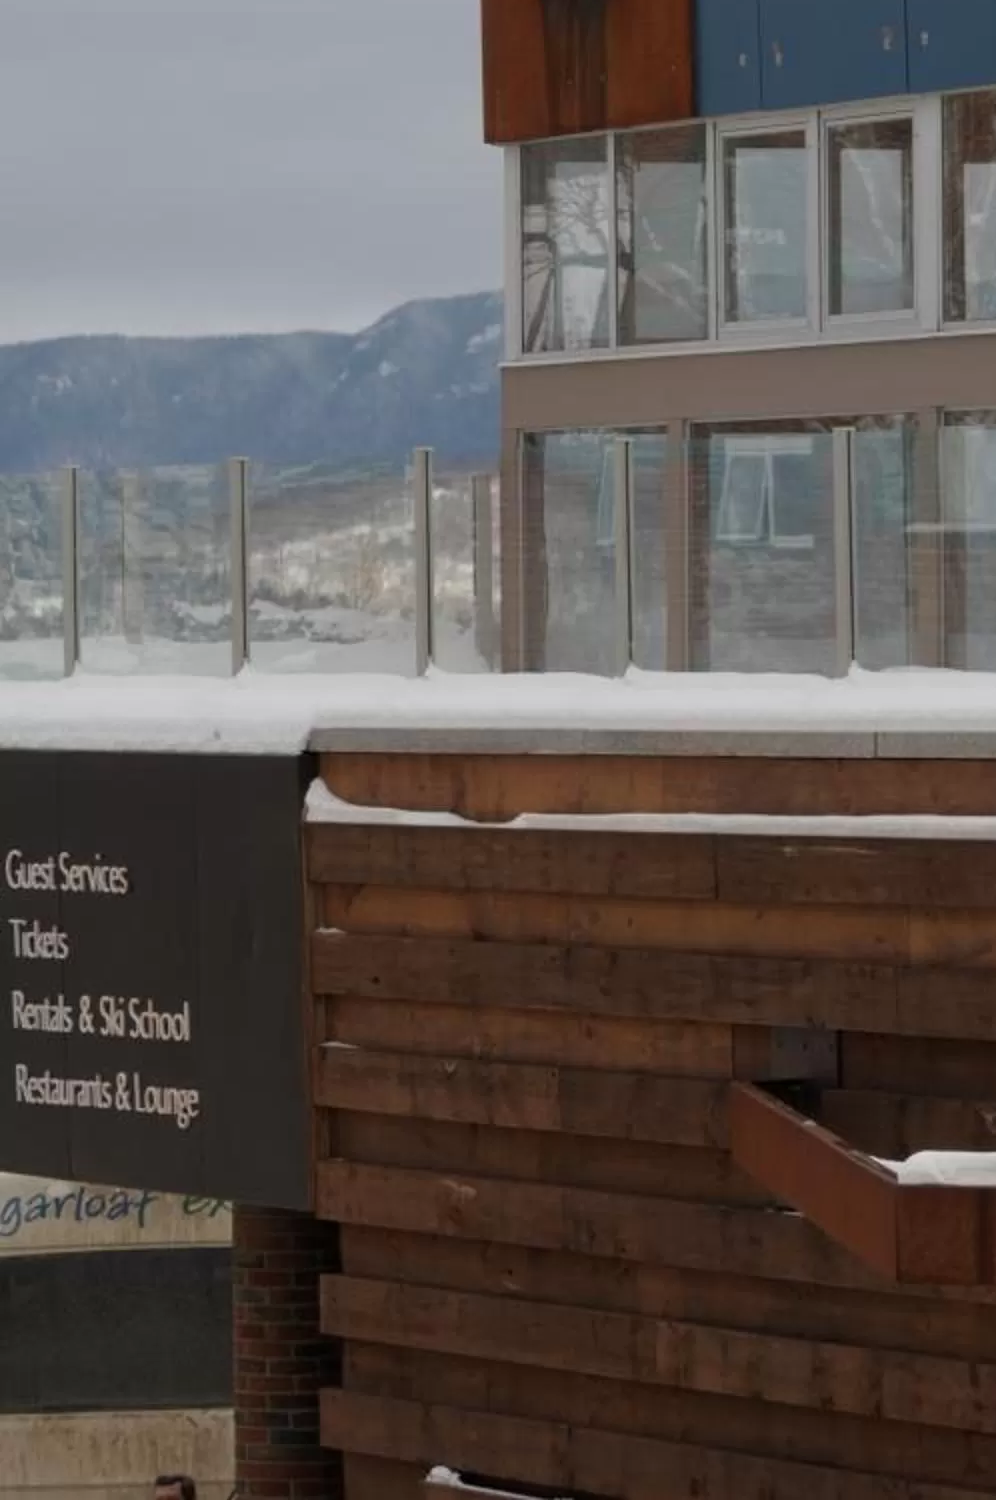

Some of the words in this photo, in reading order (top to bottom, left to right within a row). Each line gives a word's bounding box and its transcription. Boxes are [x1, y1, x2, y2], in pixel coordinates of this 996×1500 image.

[5, 849, 57, 891] Guest
[59, 852, 129, 895] Services
[8, 918, 70, 960] Tickets
[12, 990, 74, 1033] Rentals
[79, 995, 95, 1034] &
[99, 996, 125, 1038] Ski
[128, 997, 191, 1042] School
[15, 1063, 113, 1109] Restaurants
[115, 1072, 132, 1111] &
[133, 1072, 200, 1129] Lounge
